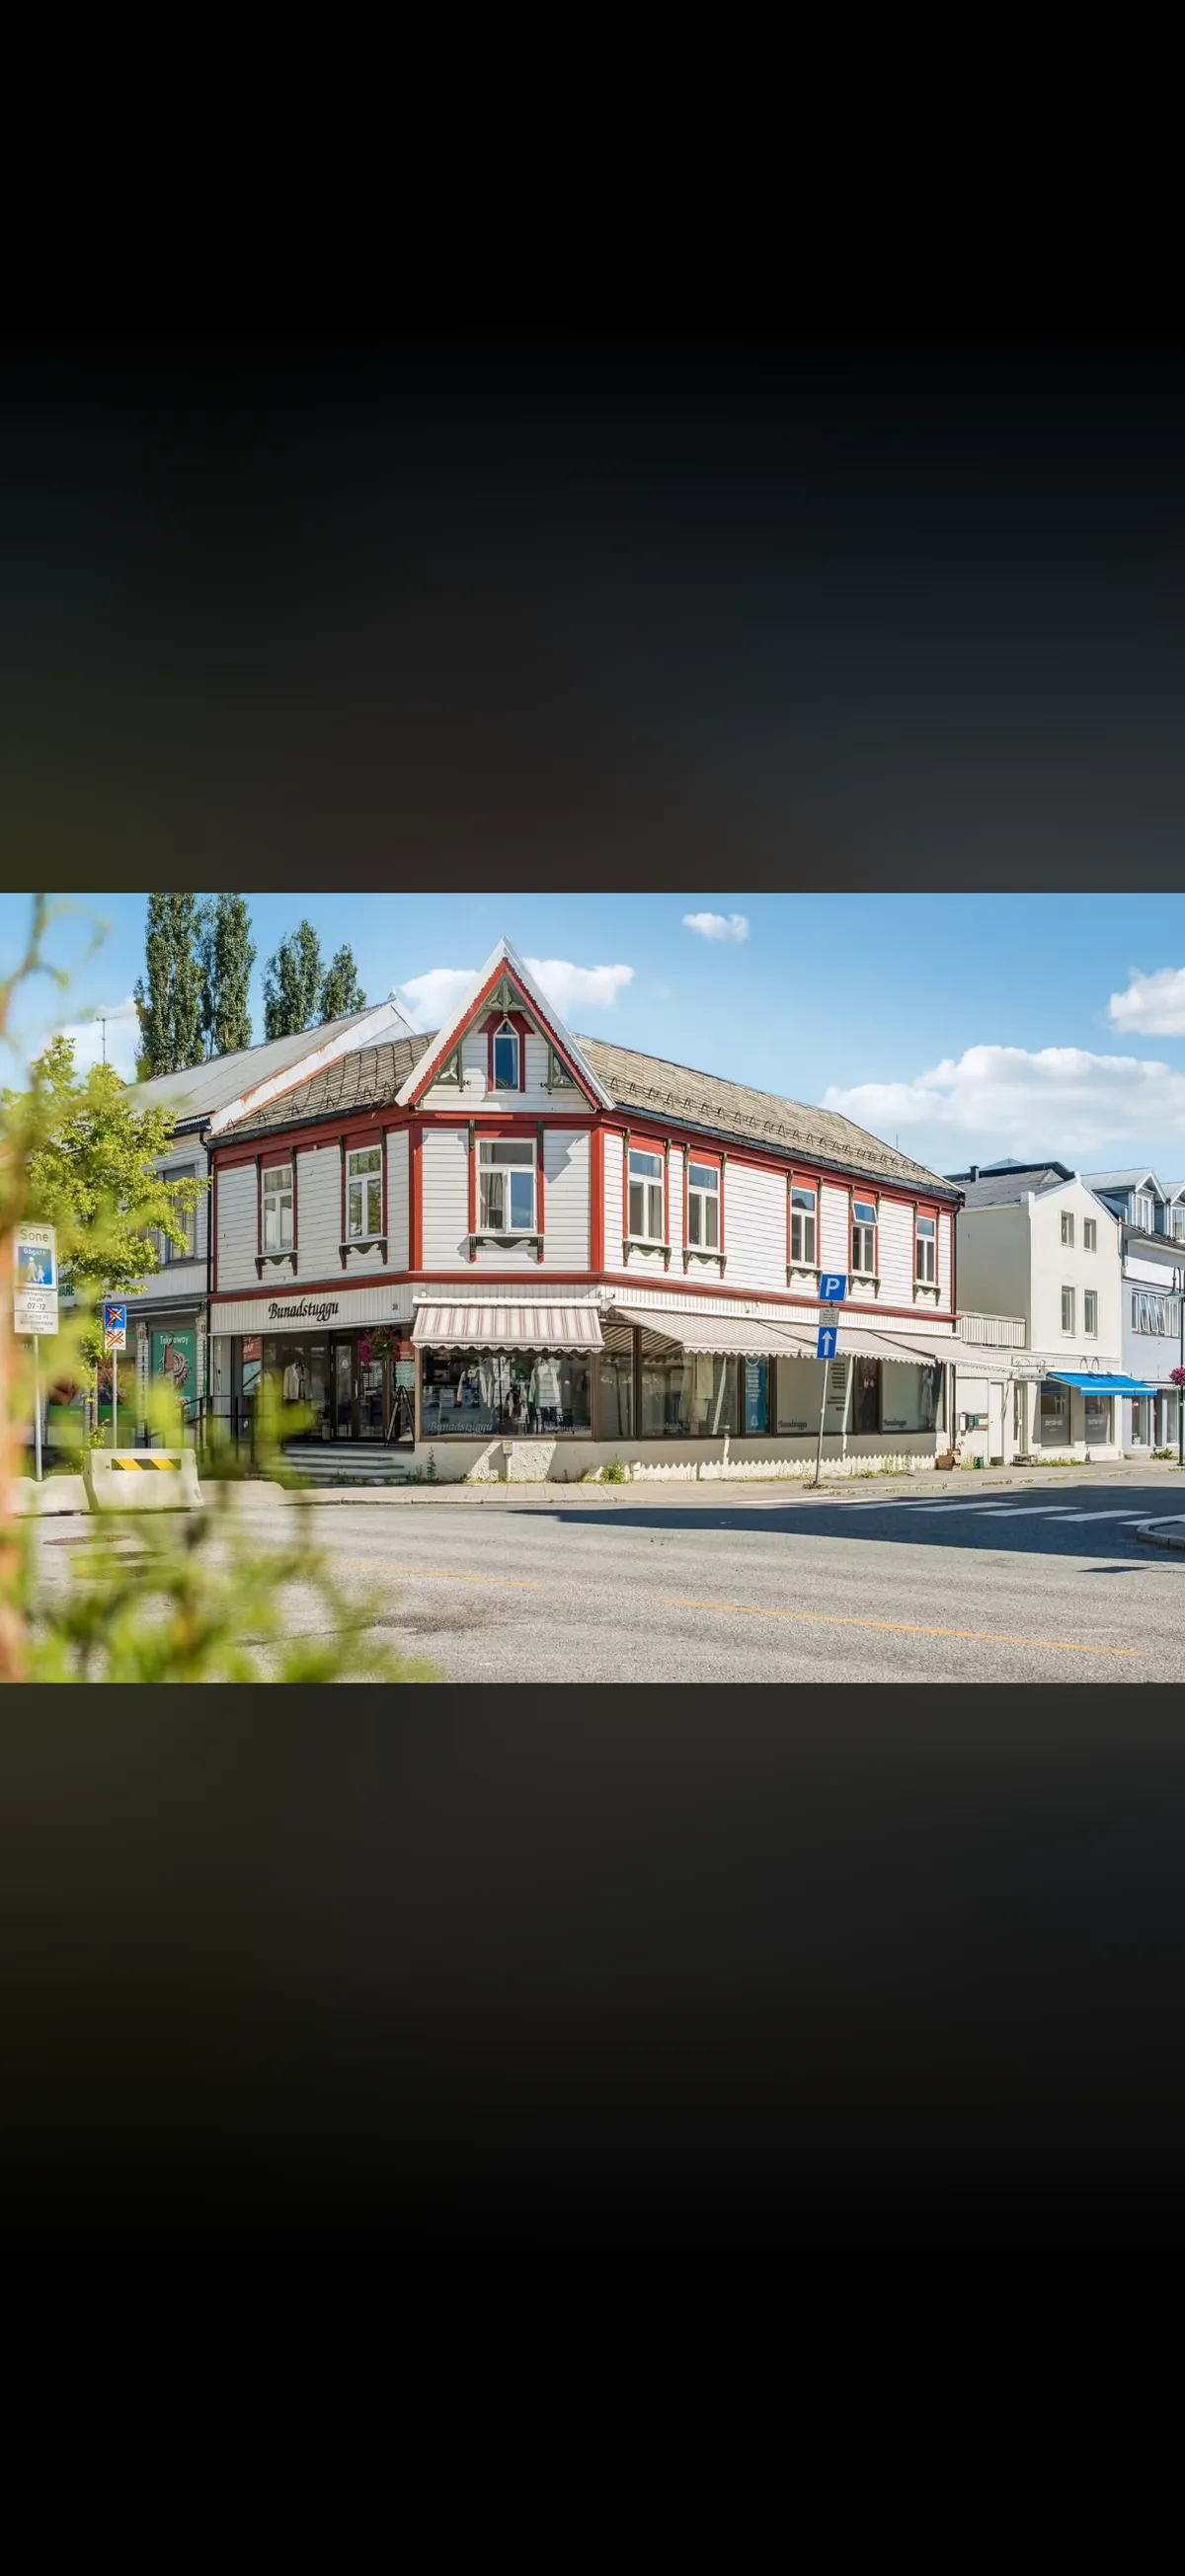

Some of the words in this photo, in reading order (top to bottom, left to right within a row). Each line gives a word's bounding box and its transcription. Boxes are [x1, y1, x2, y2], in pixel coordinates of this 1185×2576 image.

[20, 1229, 49, 1242] Sone
[826, 1278, 839, 1297] P
[269, 1298, 340, 1321] Bunadstuggu
[173, 1336, 189, 1346] away
